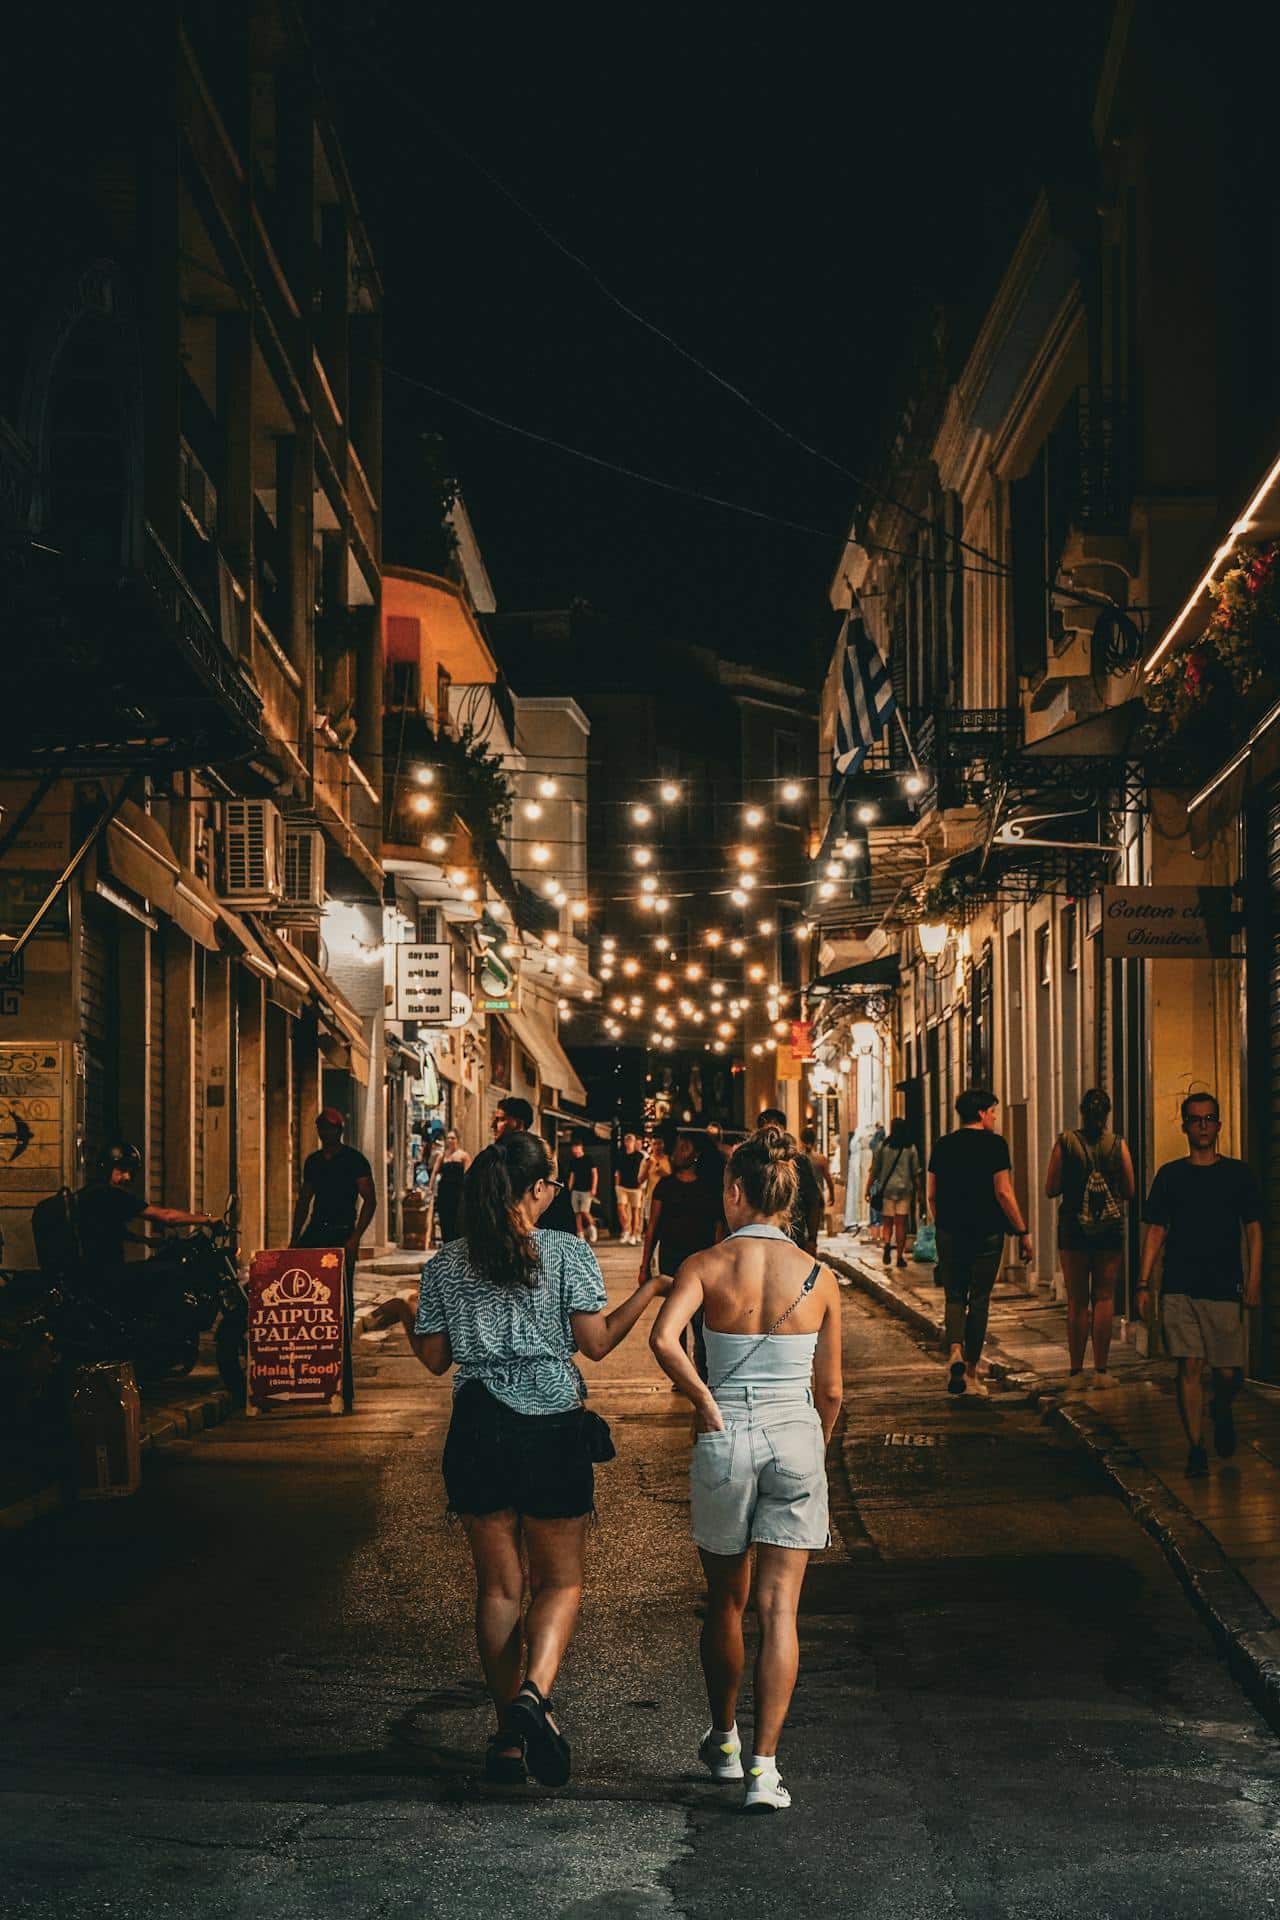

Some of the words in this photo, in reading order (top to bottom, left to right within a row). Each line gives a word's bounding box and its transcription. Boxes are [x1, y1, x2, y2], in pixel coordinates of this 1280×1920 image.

[1107, 898, 1174, 919] Cotton
[408, 951, 422, 960] day
[424, 952, 439, 960] spa
[425, 969, 439, 977] bar
[408, 1004, 423, 1013] fish
[425, 1004, 440, 1013] spa
[253, 1308, 336, 1325] JAIPUR
[253, 1325, 339, 1342] PALACE
[301, 1361, 338, 1377] Food)
